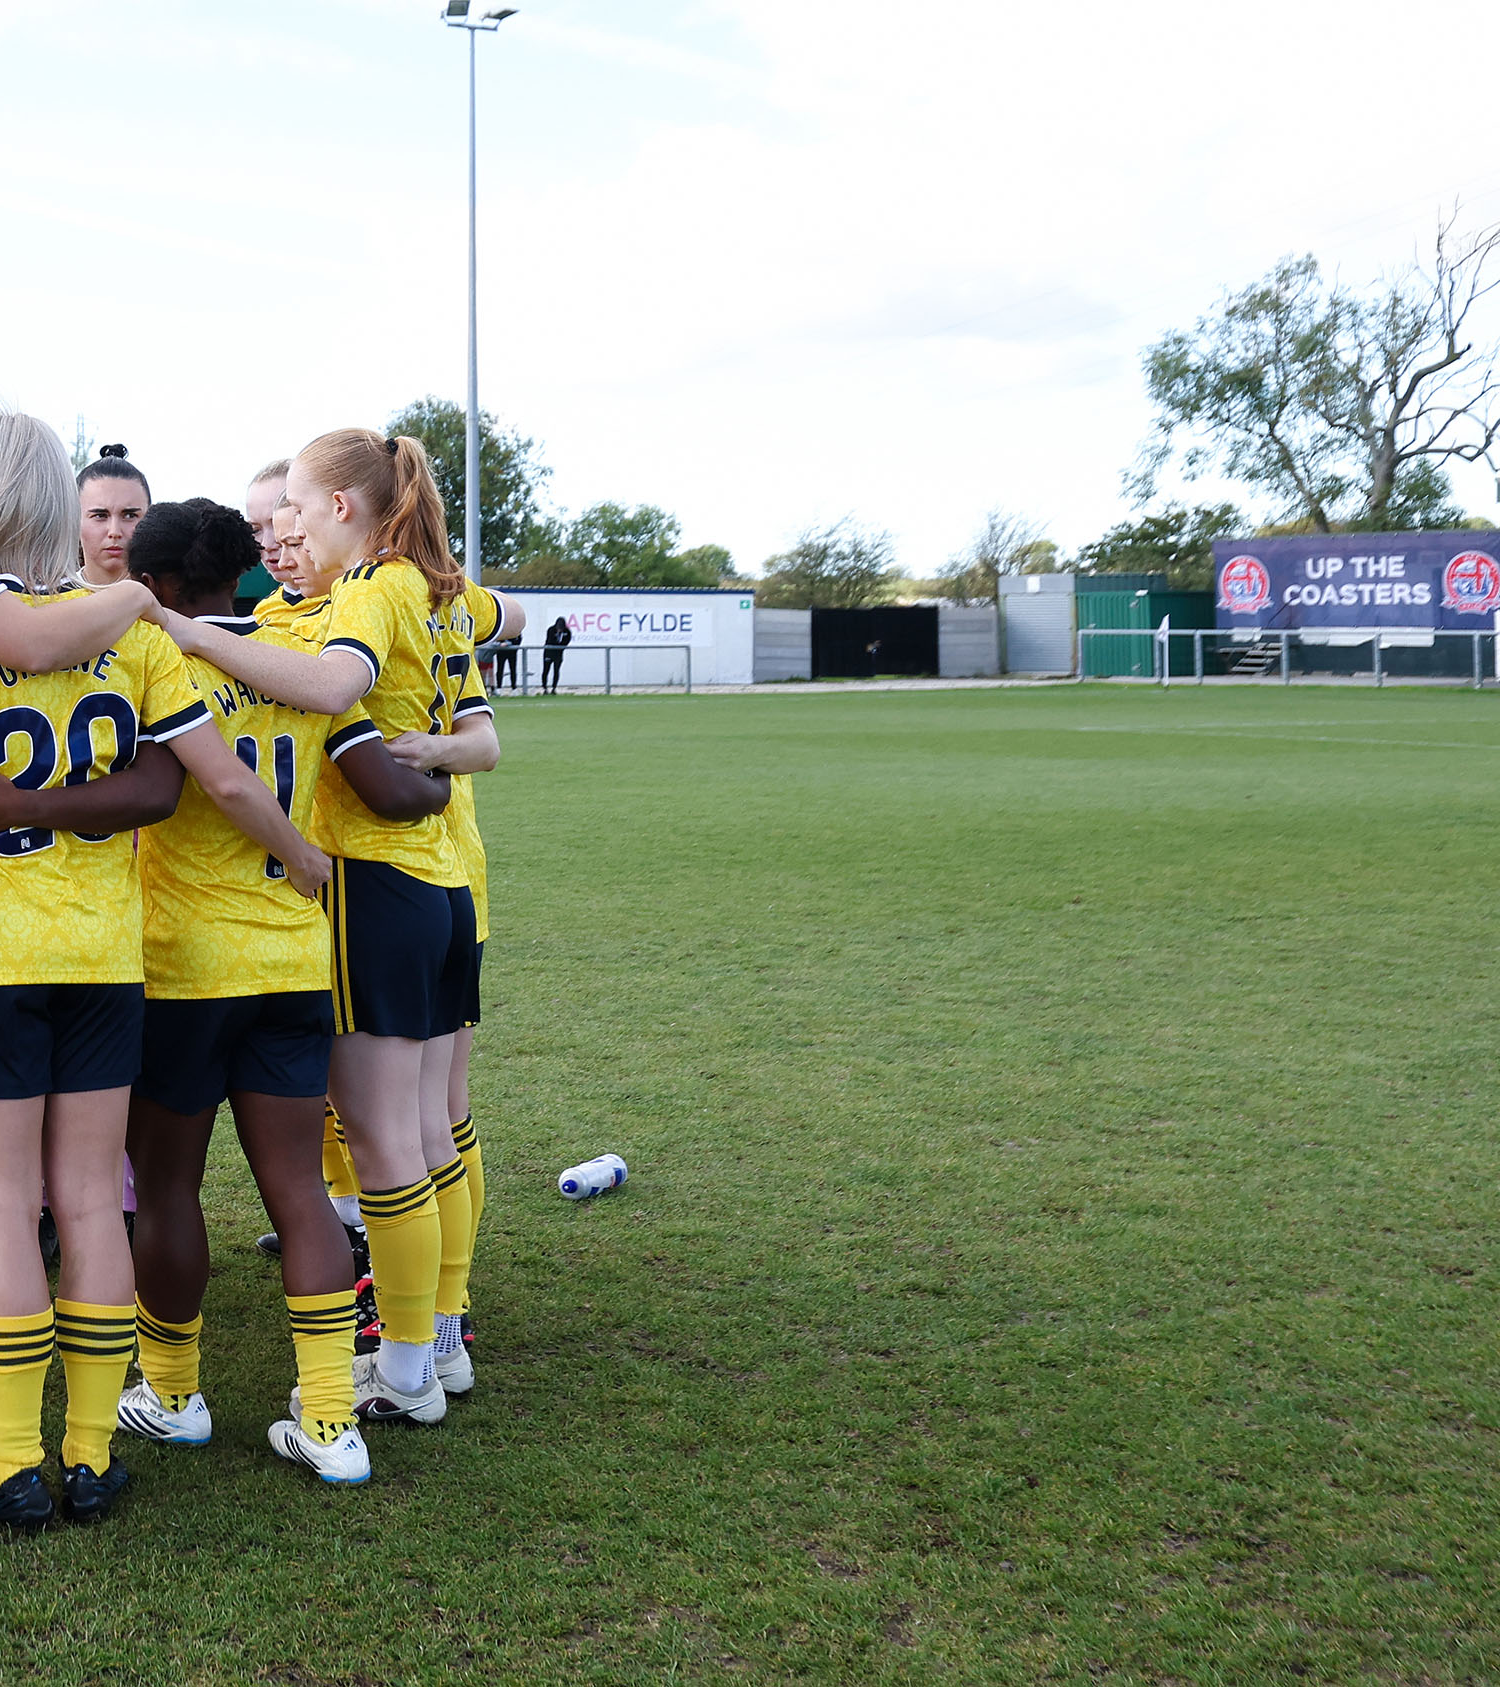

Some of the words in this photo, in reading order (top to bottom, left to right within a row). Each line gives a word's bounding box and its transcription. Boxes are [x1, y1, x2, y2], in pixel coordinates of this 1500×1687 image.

[1305, 556, 1344, 580] UP
[1349, 554, 1407, 579] THE
[1283, 582, 1432, 606] COASTERS
[566, 613, 612, 633] AFC
[619, 613, 693, 632] FYLDE
